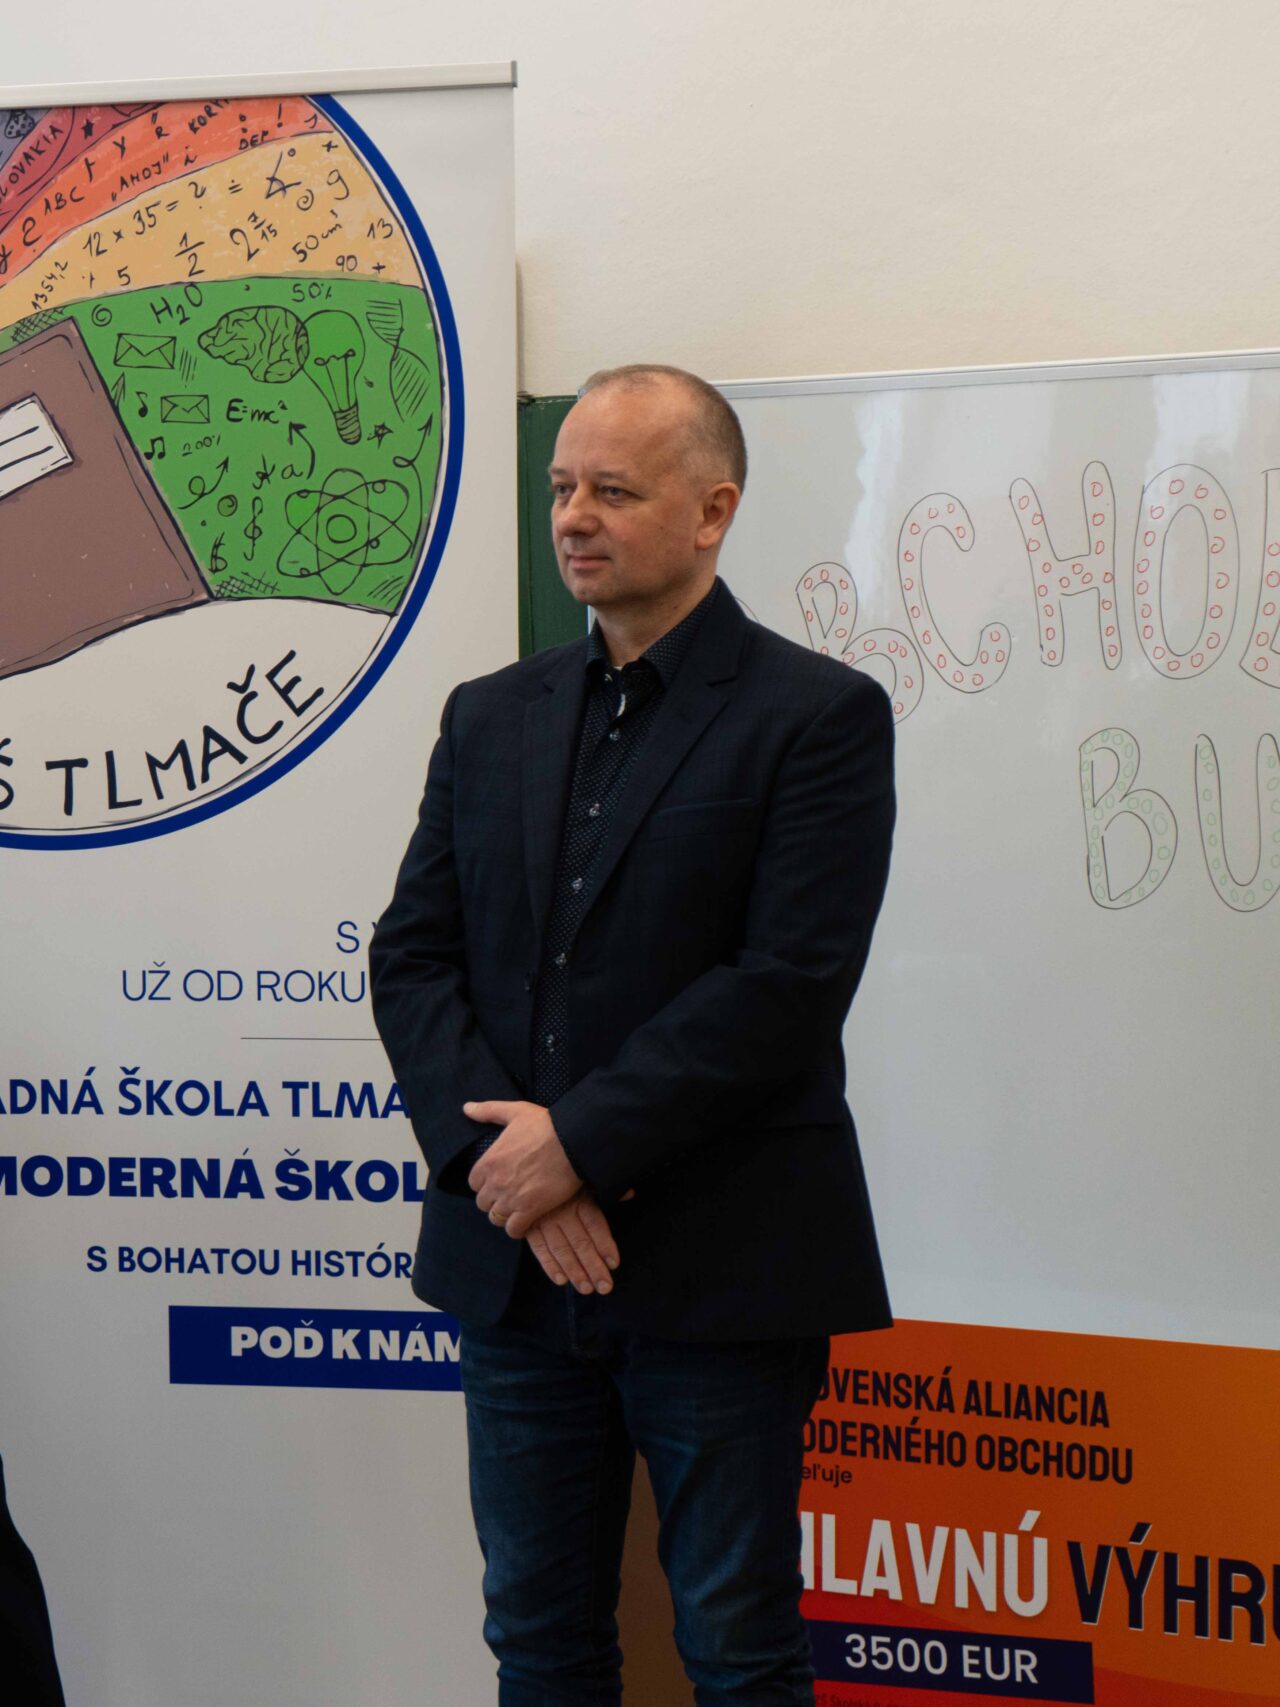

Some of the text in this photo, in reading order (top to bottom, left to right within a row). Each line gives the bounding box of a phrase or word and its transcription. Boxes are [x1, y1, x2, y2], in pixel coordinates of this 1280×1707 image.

[43, 186, 85, 216] ABC
[367, 218, 393, 239] 13
[336, 255, 358, 272] 90
[796, 461, 1280, 725] BCHO
[44, 649, 324, 817] TLMAČE
[336, 921, 360, 954] S
[121, 961, 365, 1003] UŽ OD ROKU
[118, 1066, 270, 1117] ŠKOLA
[282, 1081, 411, 1119] TLMA
[275, 1148, 428, 1203] ŠKOL
[87, 1242, 412, 1279] S BOHATOU HISTÓR
[230, 1319, 462, 1363] POĎ K NÁM
[963, 1379, 1111, 1429] ALIANCIA
[800, 1417, 1134, 1485] ODERNÉHO OBCHODU
[1066, 1522, 1280, 1647] VÝHR
[844, 1633, 1039, 1685] 3500 EUR
